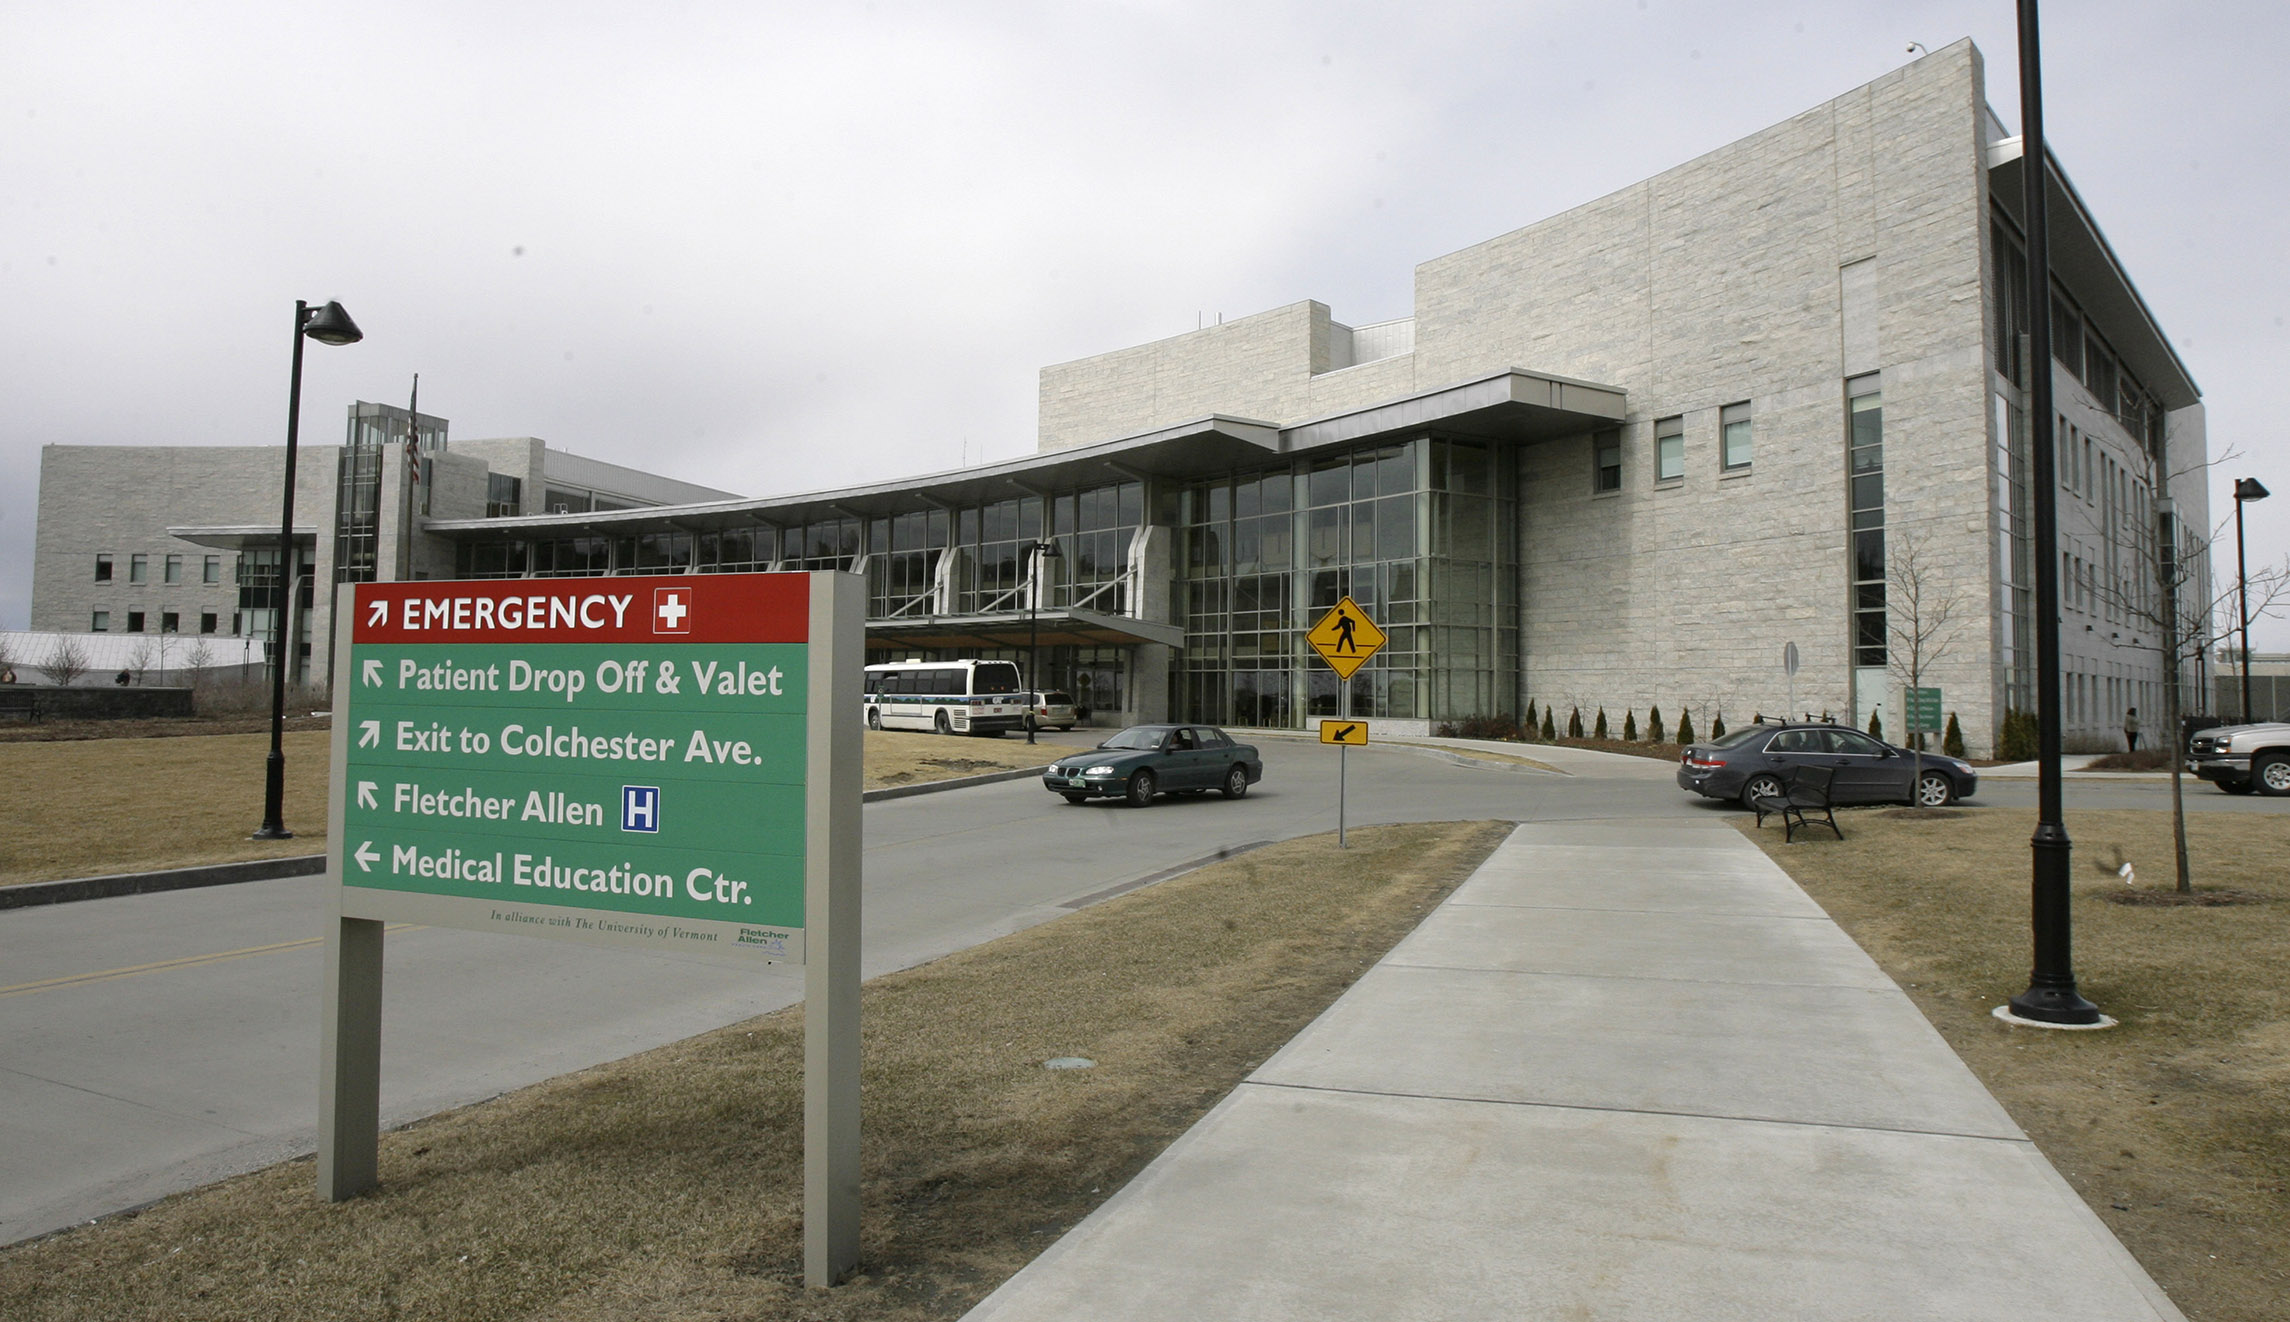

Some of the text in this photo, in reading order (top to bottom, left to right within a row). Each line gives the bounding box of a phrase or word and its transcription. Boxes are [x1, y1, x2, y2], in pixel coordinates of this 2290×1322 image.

[403, 594, 633, 630] EMERGENCY
[399, 659, 783, 702] Patient Drop Off & Valet
[397, 720, 762, 766] Exit to Colchester Ave.
[394, 783, 653, 828] Fletcher Allen H
[392, 845, 752, 905] Medical Education Ctr.
[491, 909, 718, 941] In alliance with The University of Vermont
[738, 936, 767, 944] Allen
[740, 928, 789, 939] Fletcher
